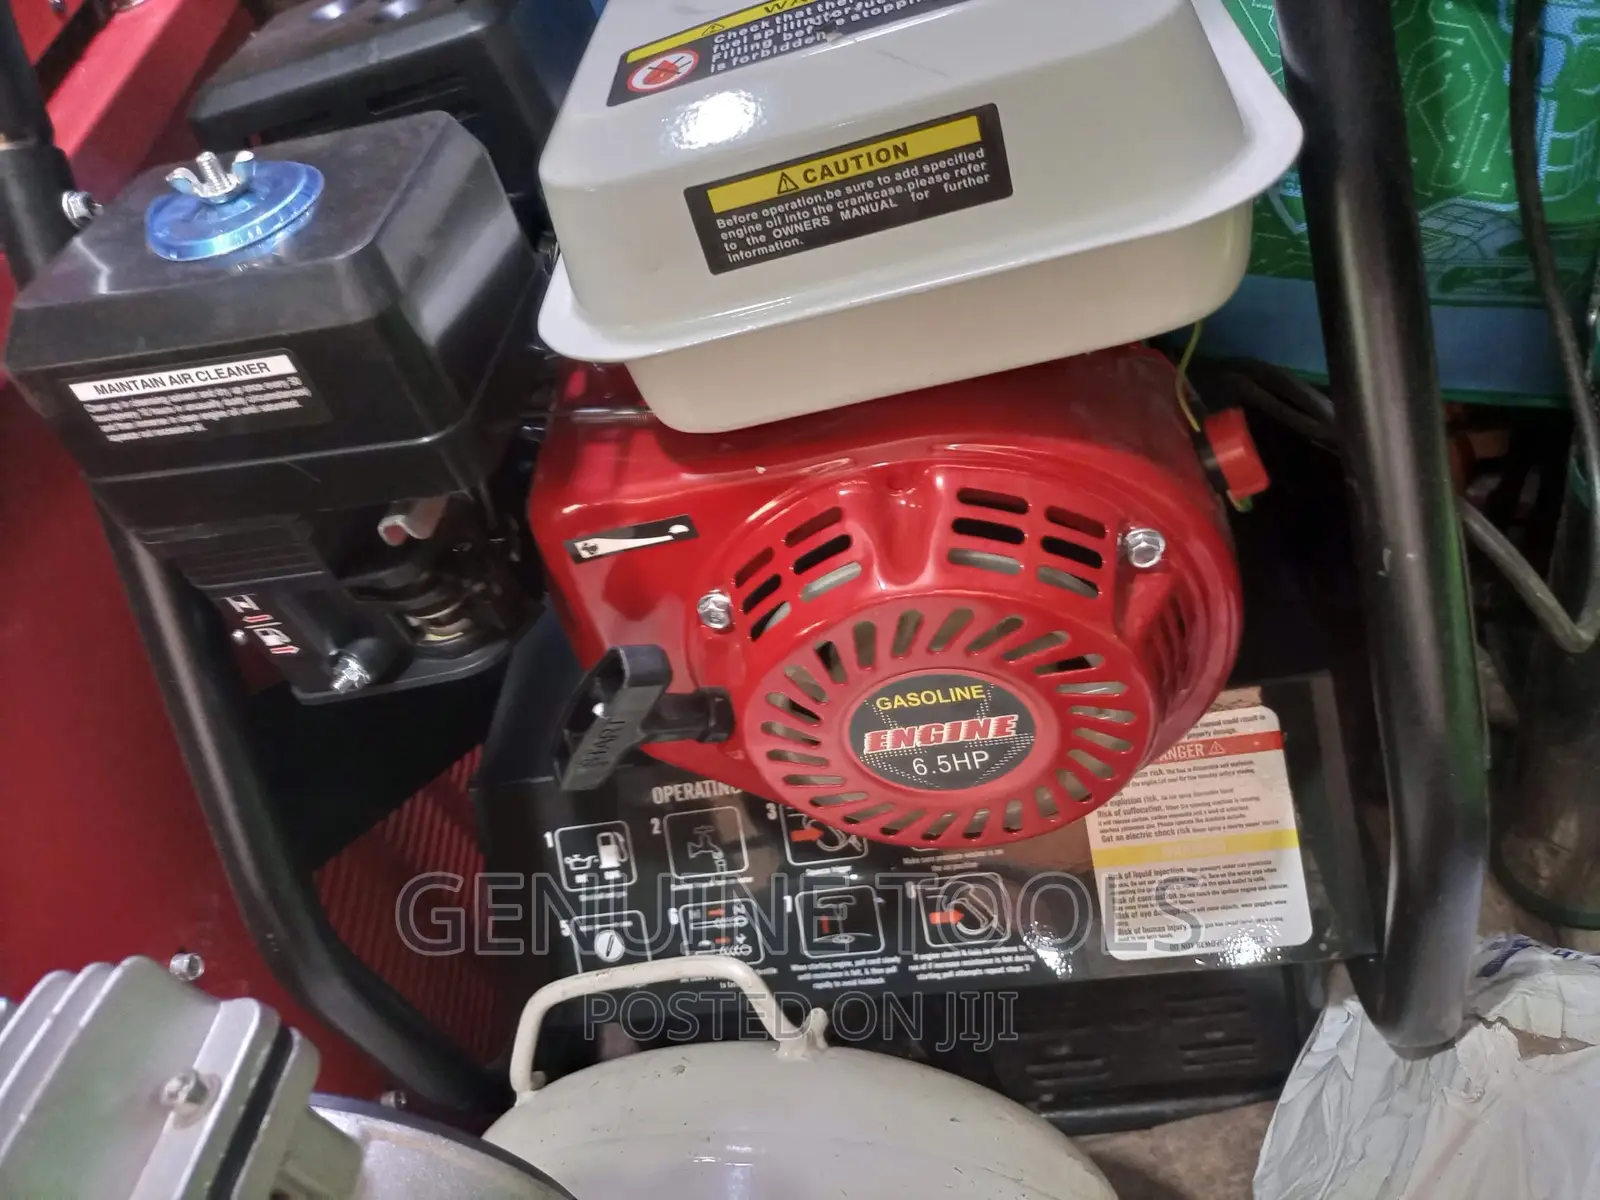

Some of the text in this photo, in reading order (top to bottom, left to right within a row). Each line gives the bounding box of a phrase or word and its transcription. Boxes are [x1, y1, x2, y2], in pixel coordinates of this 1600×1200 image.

[714, 20, 770, 44] Check
[775, 6, 812, 25] that
[783, 17, 845, 42] befe
[713, 35, 748, 54] fuel
[731, 31, 826, 67] forbidden
[803, 141, 909, 184] CAUTION
[716, 211, 759, 230] Before
[845, 179, 875, 195] sure
[877, 174, 891, 186] to
[894, 165, 919, 181] add
[922, 146, 985, 174] specified
[720, 222, 763, 241] engine
[766, 214, 782, 229] oil
[784, 207, 810, 224] into
[813, 202, 833, 217] the
[954, 160, 987, 178] refer
[724, 172, 990, 253] to the OWNERS MANUAL for further
[727, 236, 804, 264] information.
[93, 375, 167, 397] MAINTAIN
[169, 370, 194, 387] AIR
[195, 361, 272, 383] CLEANER
[875, 684, 986, 711] GASOLINE
[862, 714, 1019, 756] ENGINE
[912, 750, 991, 777] 6.5HP
[1158, 743, 1205, 762] ANGER
[766, 802, 777, 820] 3
[544, 831, 554, 848] 1
[651, 817, 661, 834] 2
